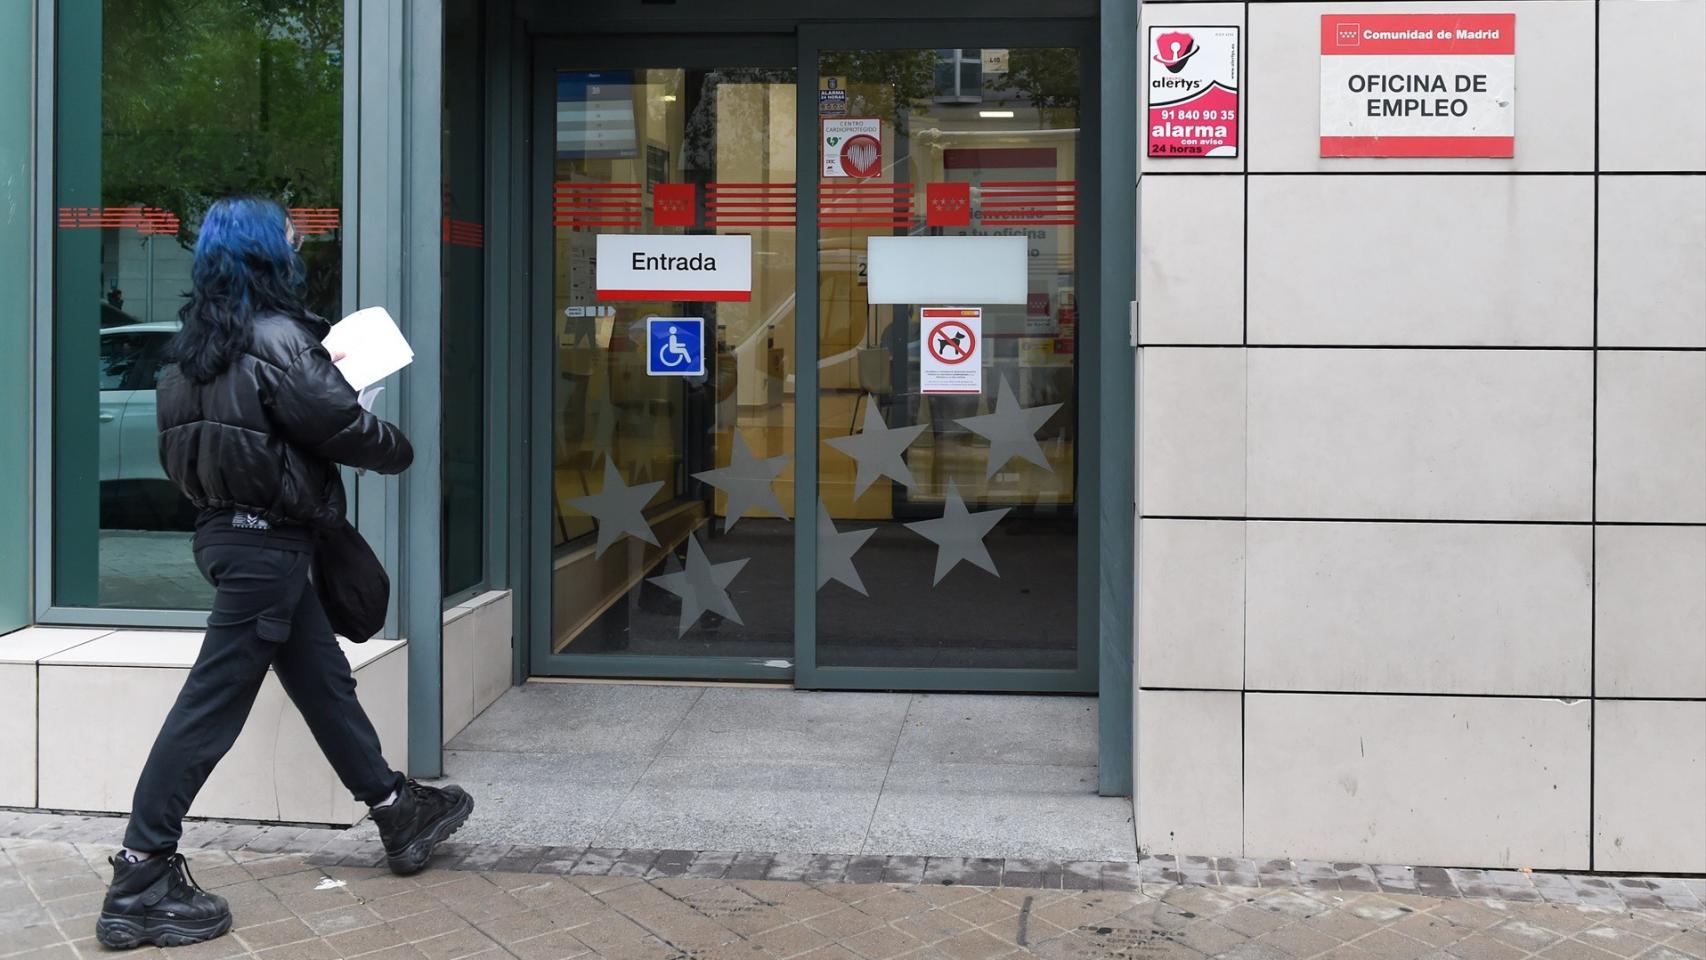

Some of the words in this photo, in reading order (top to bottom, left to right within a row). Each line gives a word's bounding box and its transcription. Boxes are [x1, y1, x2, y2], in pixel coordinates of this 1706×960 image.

[1363, 29, 1433, 40] Comunidad
[1437, 29, 1452, 40] de
[1456, 29, 1500, 40] Madrid
[1152, 76, 1200, 91] alertys
[1348, 74, 1447, 93] OFICINA
[1455, 74, 1487, 93] DE
[1161, 110, 1174, 120] 91
[1178, 110, 1200, 120] 840
[1203, 110, 1217, 120] 90
[1220, 110, 1235, 120] 35
[1367, 98, 1468, 117] EMPLEO
[1151, 121, 1227, 138] alarma
[1152, 144, 1166, 153] 24
[1170, 144, 1202, 153] horas
[632, 252, 716, 271] Entrada
